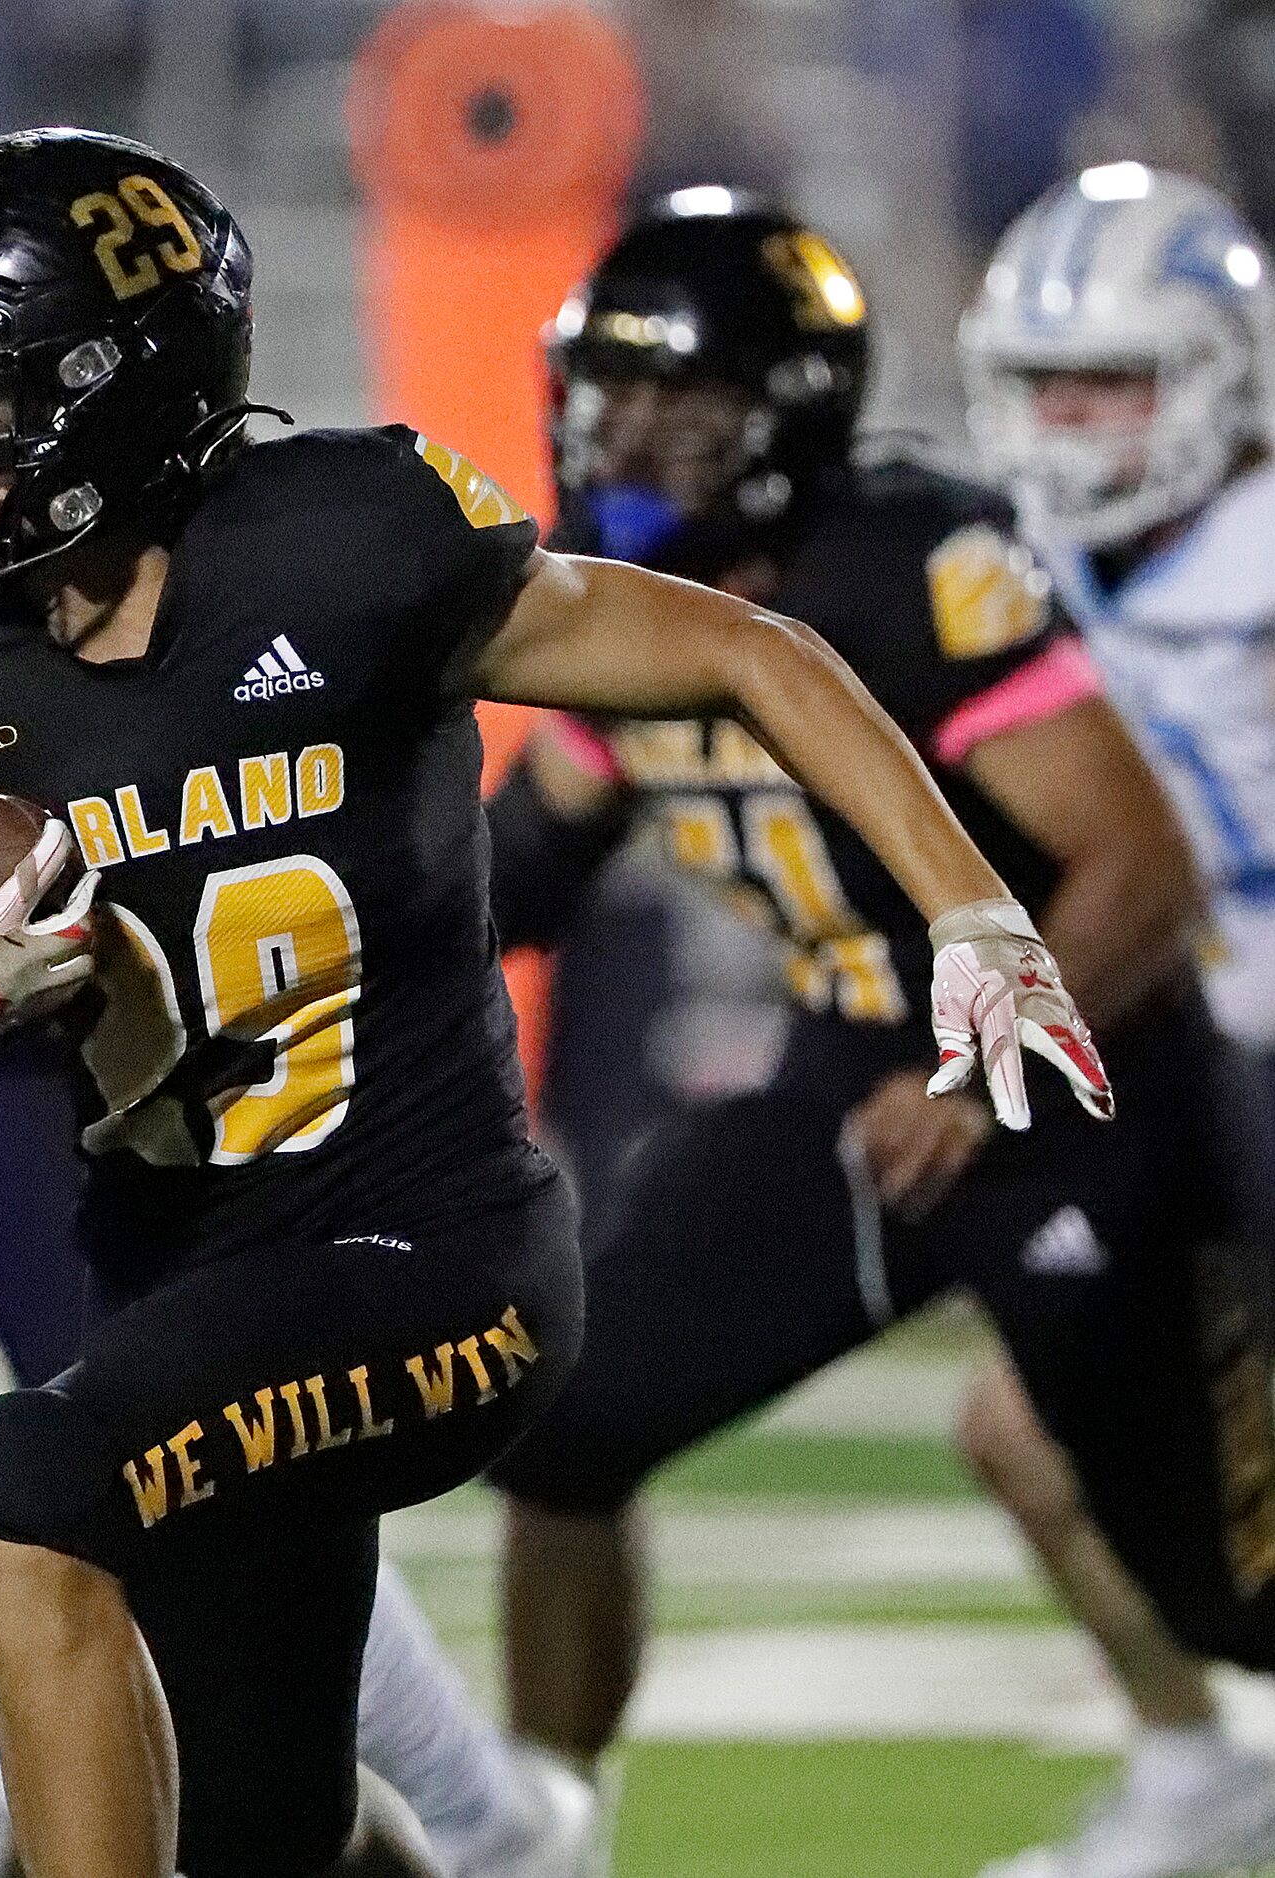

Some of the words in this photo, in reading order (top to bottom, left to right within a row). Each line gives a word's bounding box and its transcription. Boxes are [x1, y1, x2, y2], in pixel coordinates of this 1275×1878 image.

[70, 174, 201, 300] 29
[233, 668, 325, 701] adidas
[123, 1420, 214, 1528] WE
[223, 1364, 394, 1474] WILL
[405, 1304, 539, 1420] WIN
